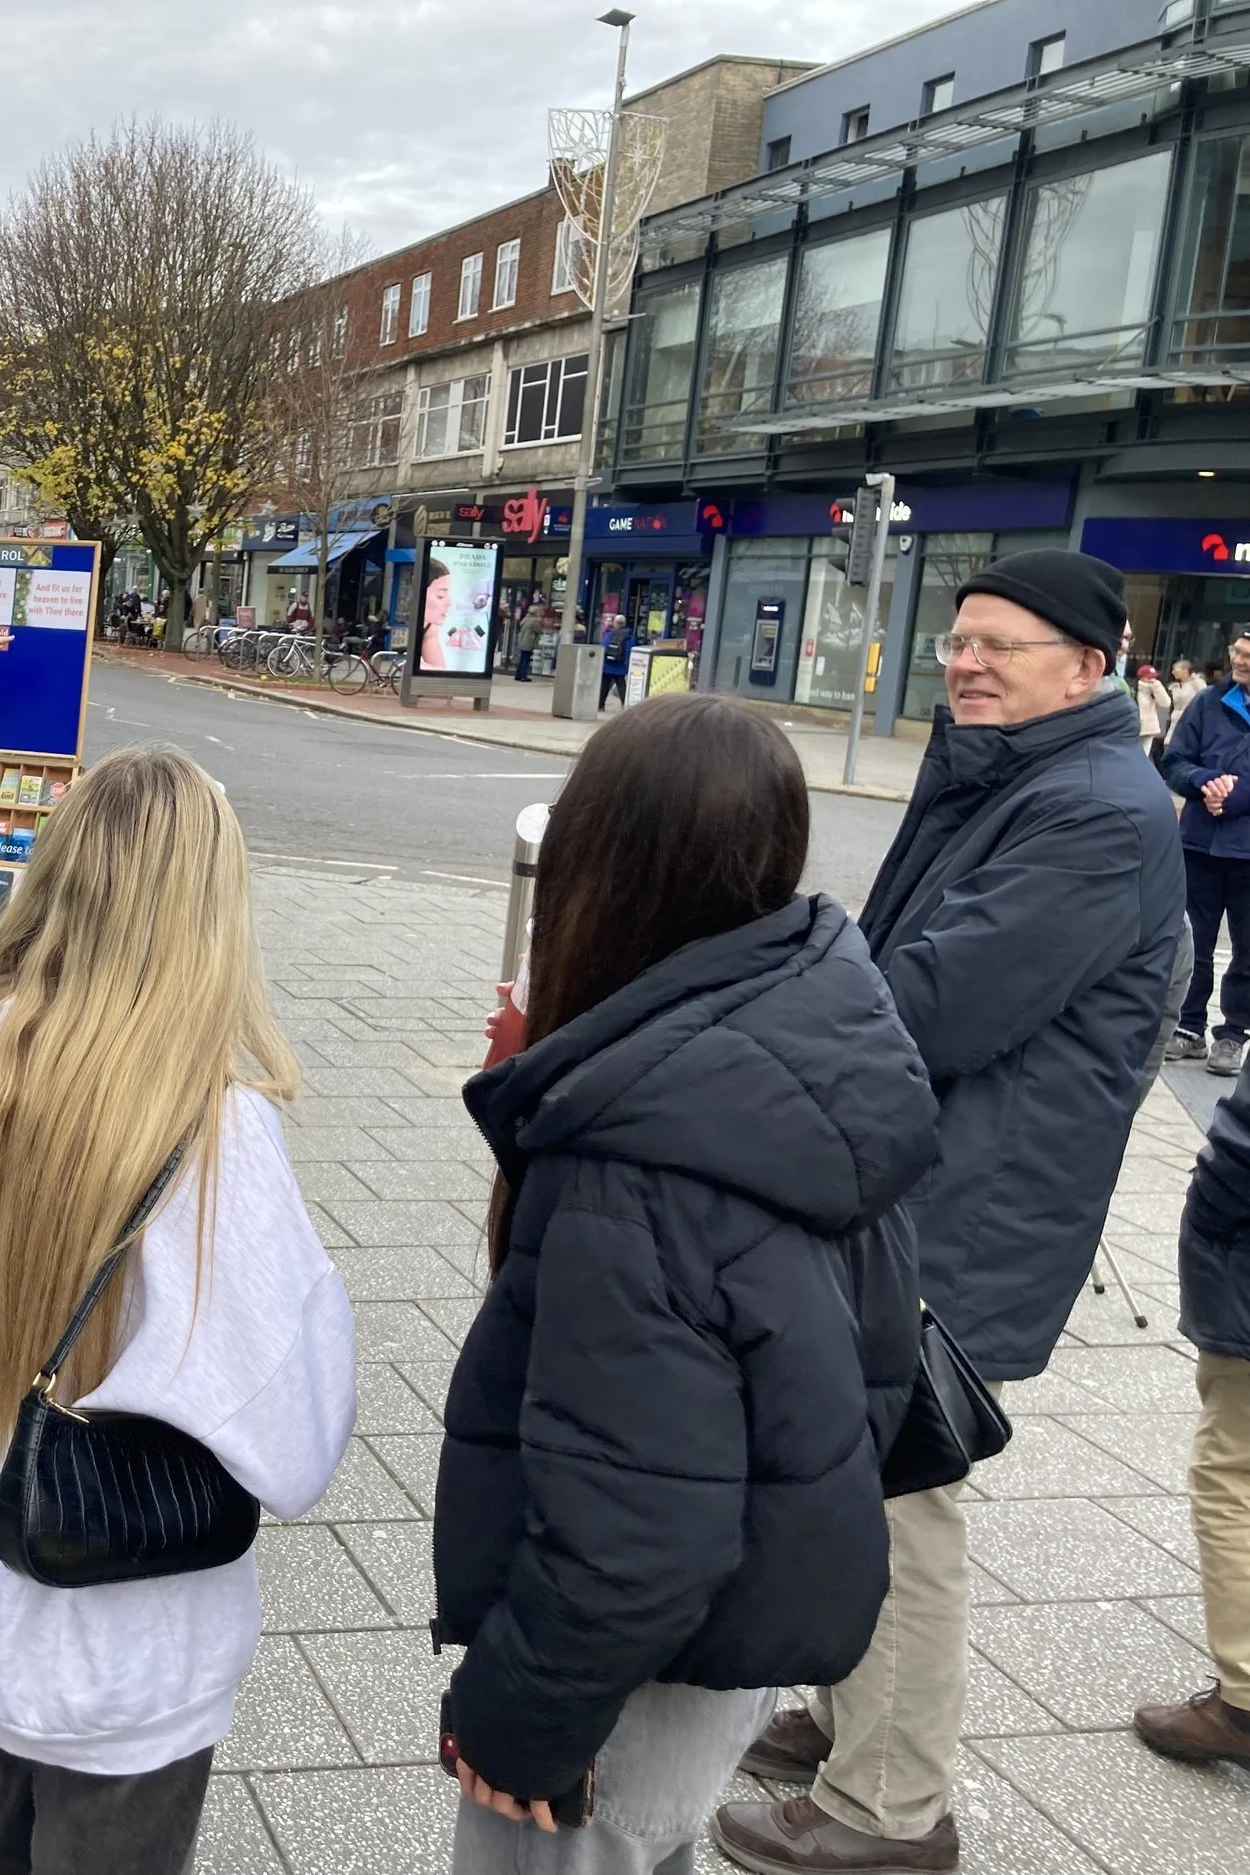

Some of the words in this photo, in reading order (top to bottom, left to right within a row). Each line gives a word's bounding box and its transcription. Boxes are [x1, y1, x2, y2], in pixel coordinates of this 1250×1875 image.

[458, 505, 485, 521] sally
[502, 487, 549, 544] sally
[35, 583, 50, 592] And
[51, 584, 61, 592] fit
[61, 585, 71, 593] us
[71, 584, 83, 594] for
[33, 595, 59, 604] heaven
[60, 596, 69, 604] to
[69, 596, 83, 605] live
[28, 606, 44, 615] with
[45, 607, 63, 616] Thee
[64, 608, 86, 617] there.
[820, 689, 833, 700] way
[842, 690, 856, 701] ban
